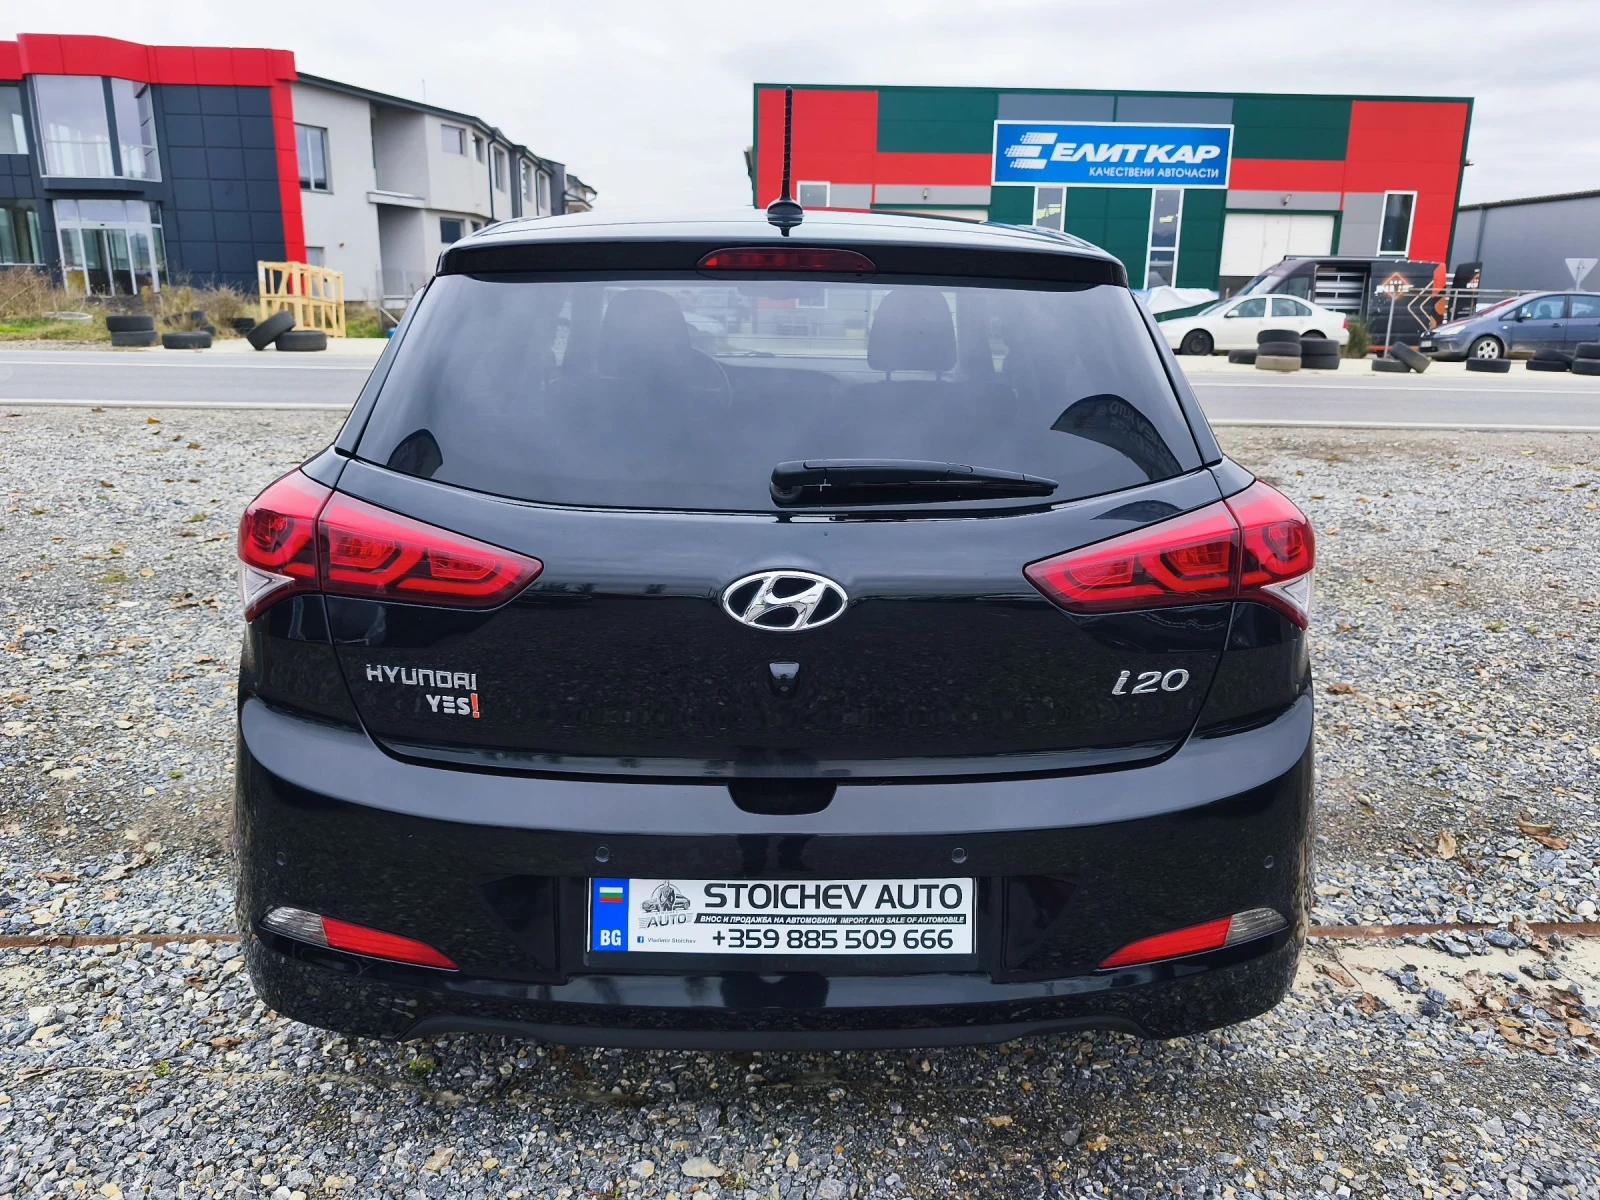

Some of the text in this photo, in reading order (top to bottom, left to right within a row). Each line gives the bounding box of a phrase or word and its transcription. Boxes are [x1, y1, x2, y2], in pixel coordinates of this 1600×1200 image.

[1089, 167, 1219, 178] КАЧЕСТВЕНИ АВТОЧАСТИ
[366, 664, 477, 690] HYUNDAI
[1111, 668, 1190, 696] i20
[425, 693, 480, 719] YES!
[704, 883, 963, 909] STOICHEV AUTO
[647, 913, 687, 928] AUTO
[700, 915, 722, 923] ВНОС
[730, 916, 772, 924] ПРОДАЖБА
[906, 916, 916, 924] OF
[917, 916, 965, 924] AUTOMOBILE
[600, 928, 622, 946] BG
[712, 928, 954, 949] +359 885 509 666
